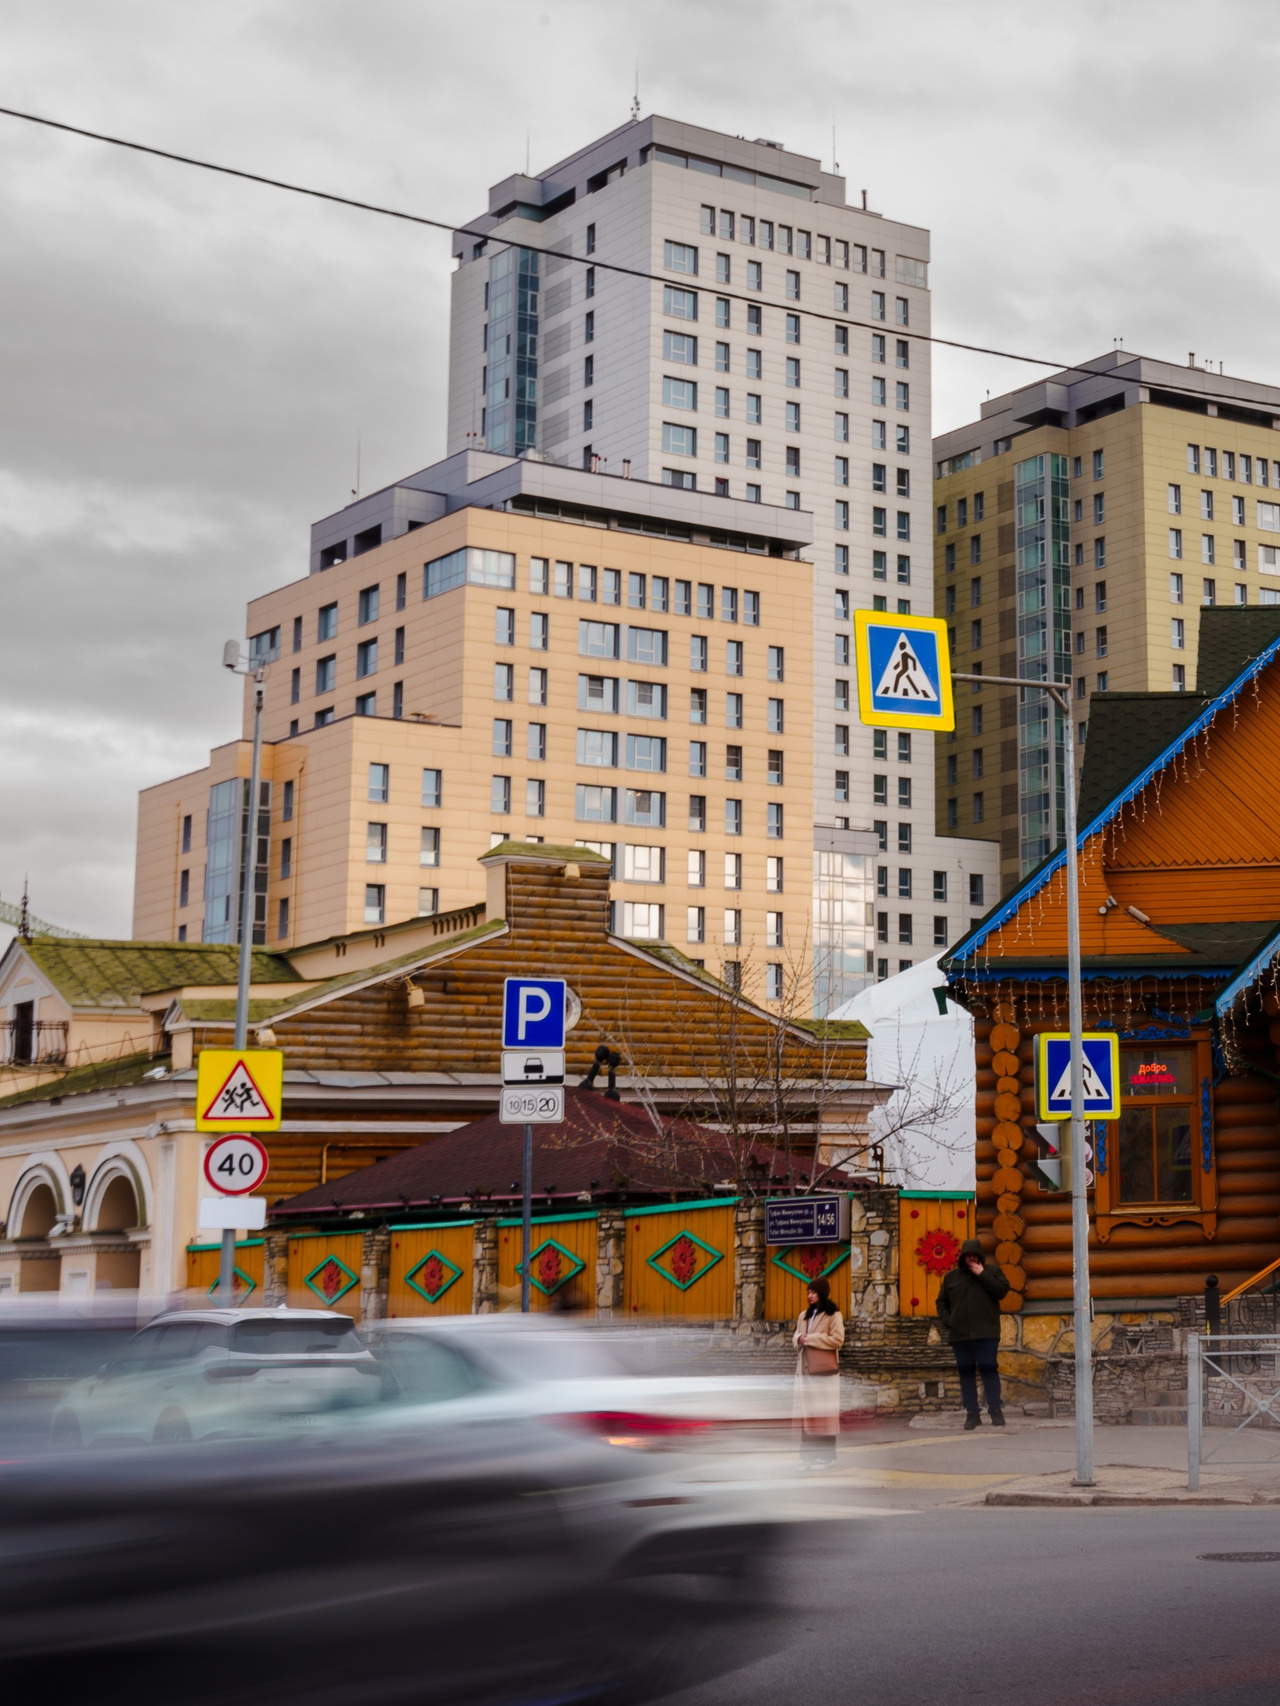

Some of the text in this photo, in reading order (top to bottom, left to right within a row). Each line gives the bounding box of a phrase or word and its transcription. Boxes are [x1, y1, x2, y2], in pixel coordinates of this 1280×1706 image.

[518, 986, 551, 1040] P
[1138, 1062, 1167, 1075] Добро
[509, 1098, 556, 1112] 10 15 20
[217, 1153, 254, 1176] 40
[817, 1212, 835, 1226] 14/56
